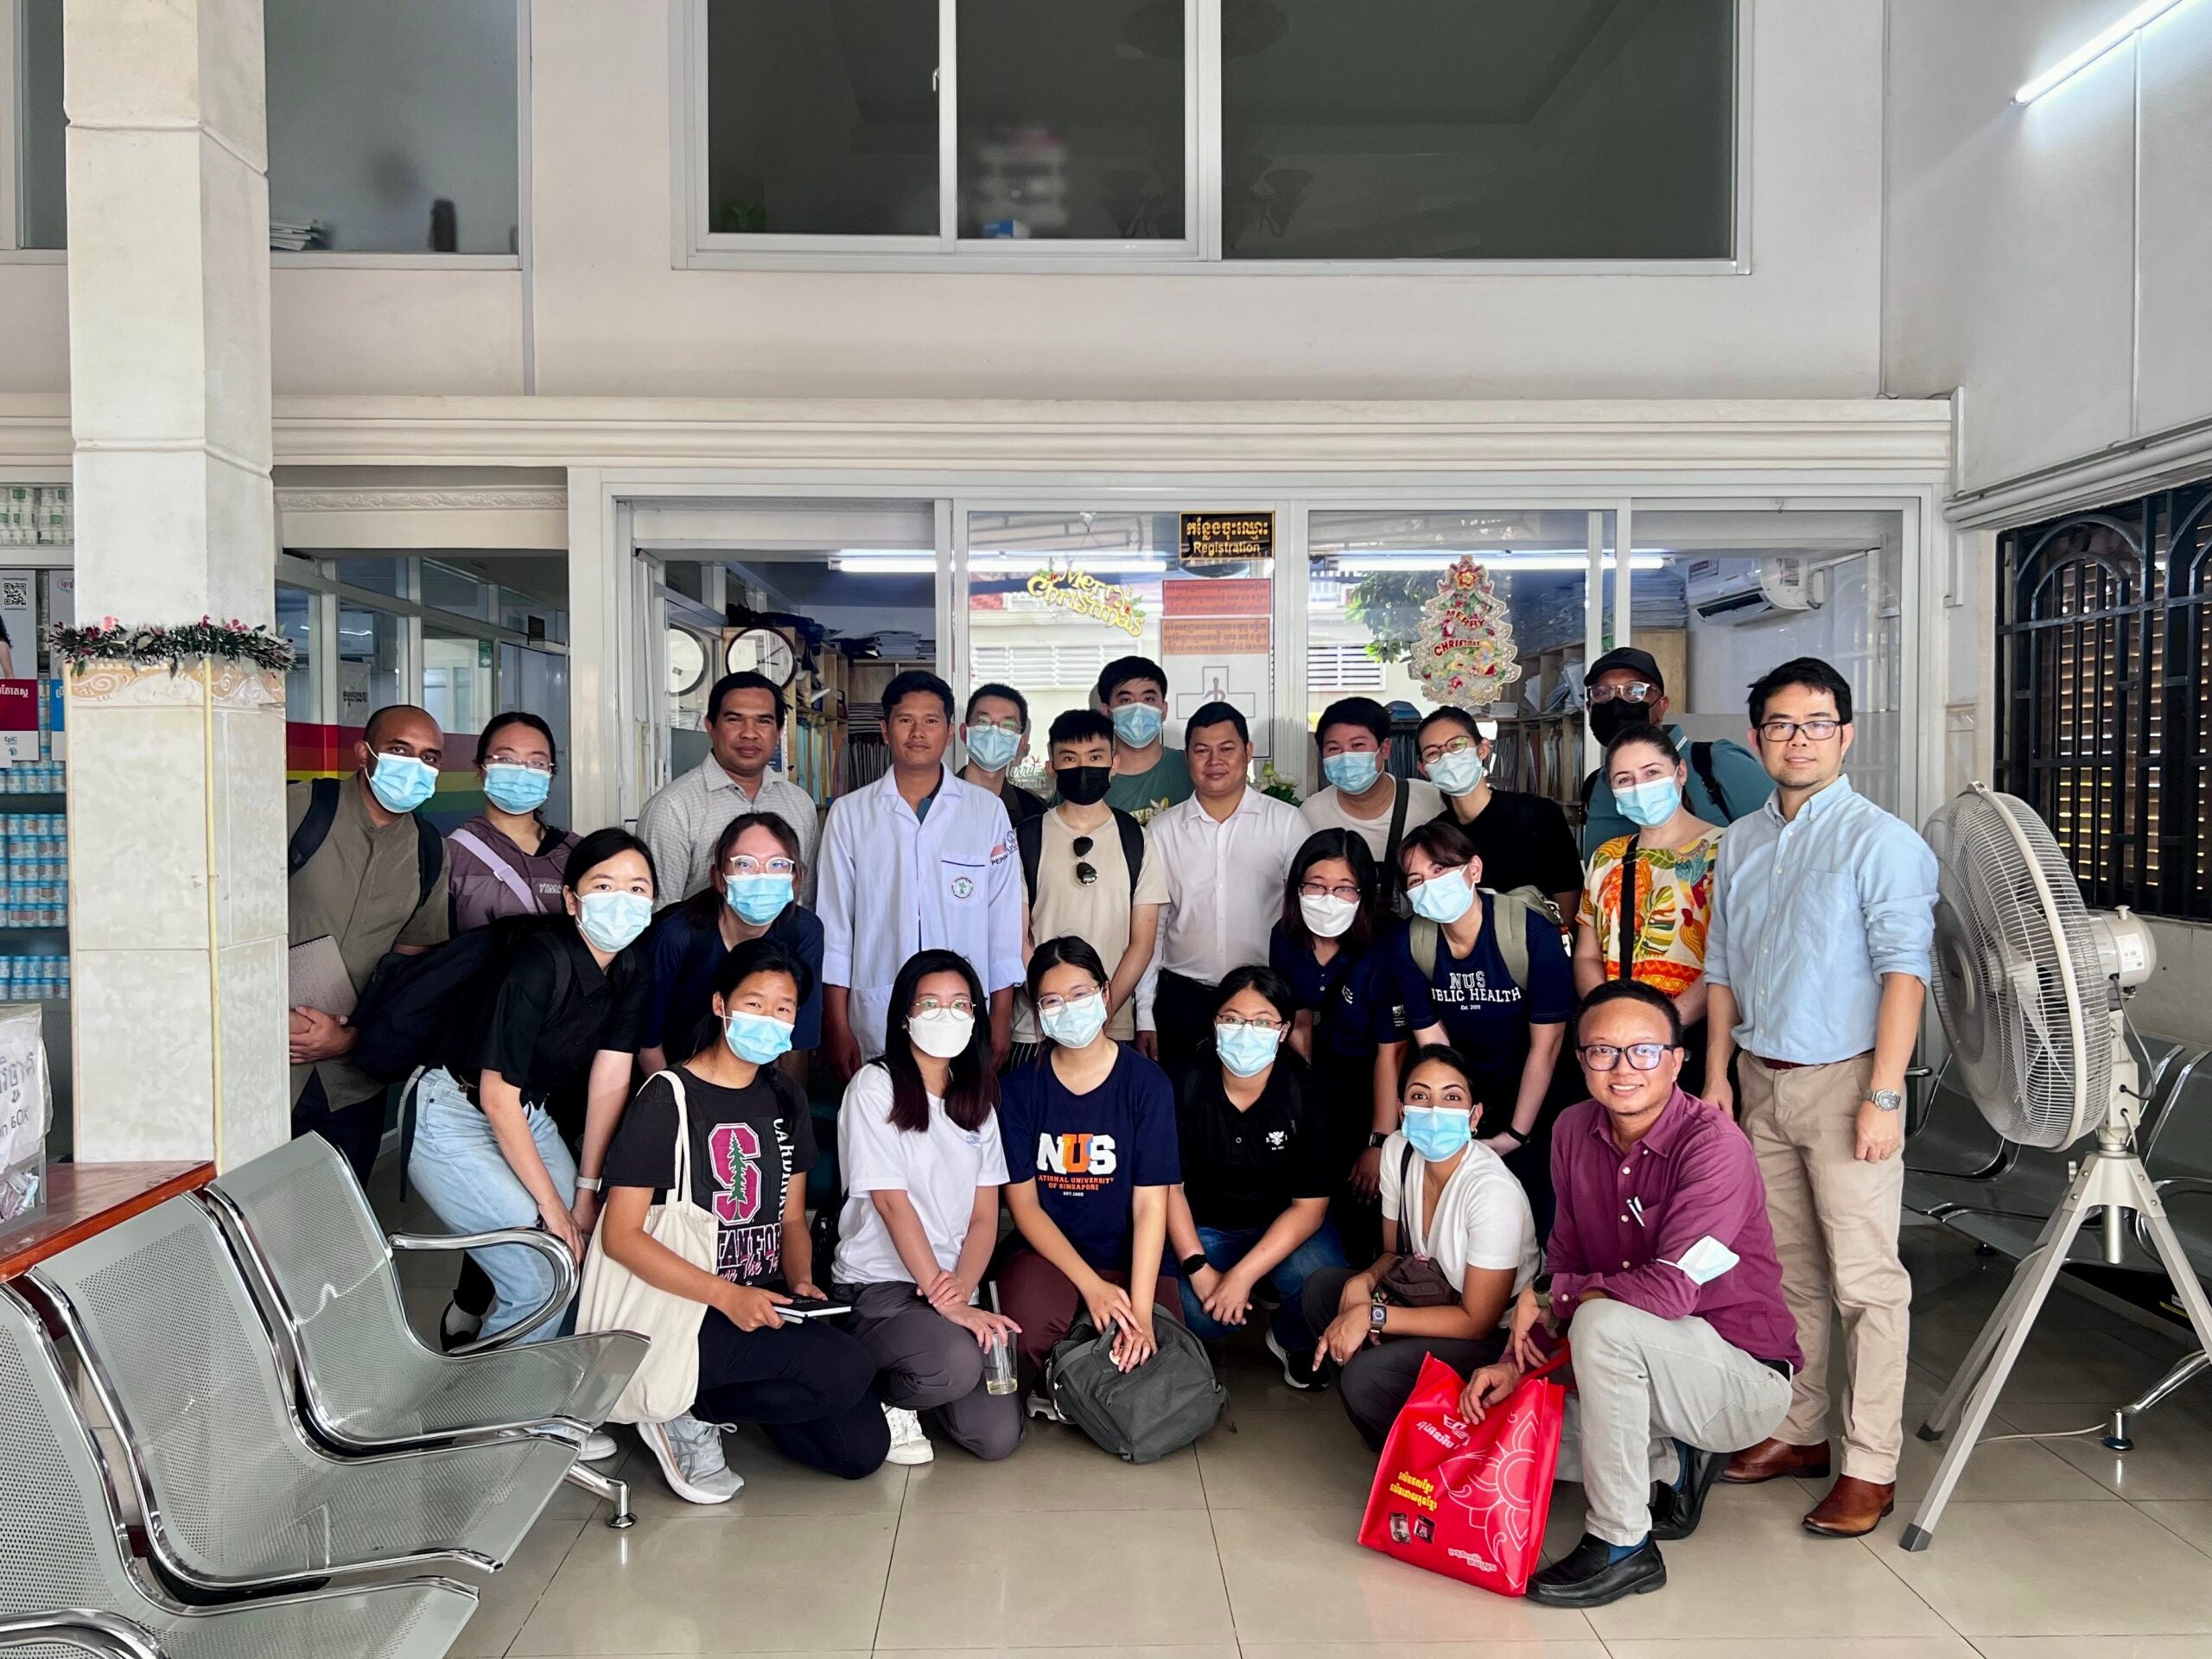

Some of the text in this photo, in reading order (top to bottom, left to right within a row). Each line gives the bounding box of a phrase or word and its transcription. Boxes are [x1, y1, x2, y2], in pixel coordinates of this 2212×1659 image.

[1193, 541, 1260, 556] Registration
[1058, 568, 1133, 608] Merry
[1027, 575, 1145, 638] Christmas
[1446, 610, 1485, 628] MERRY
[1449, 970, 1486, 989] NUS
[1431, 987, 1522, 1002] BLIC HEALTH
[1036, 1132, 1117, 1175] NUS
[717, 1223, 782, 1268] TANFOR
